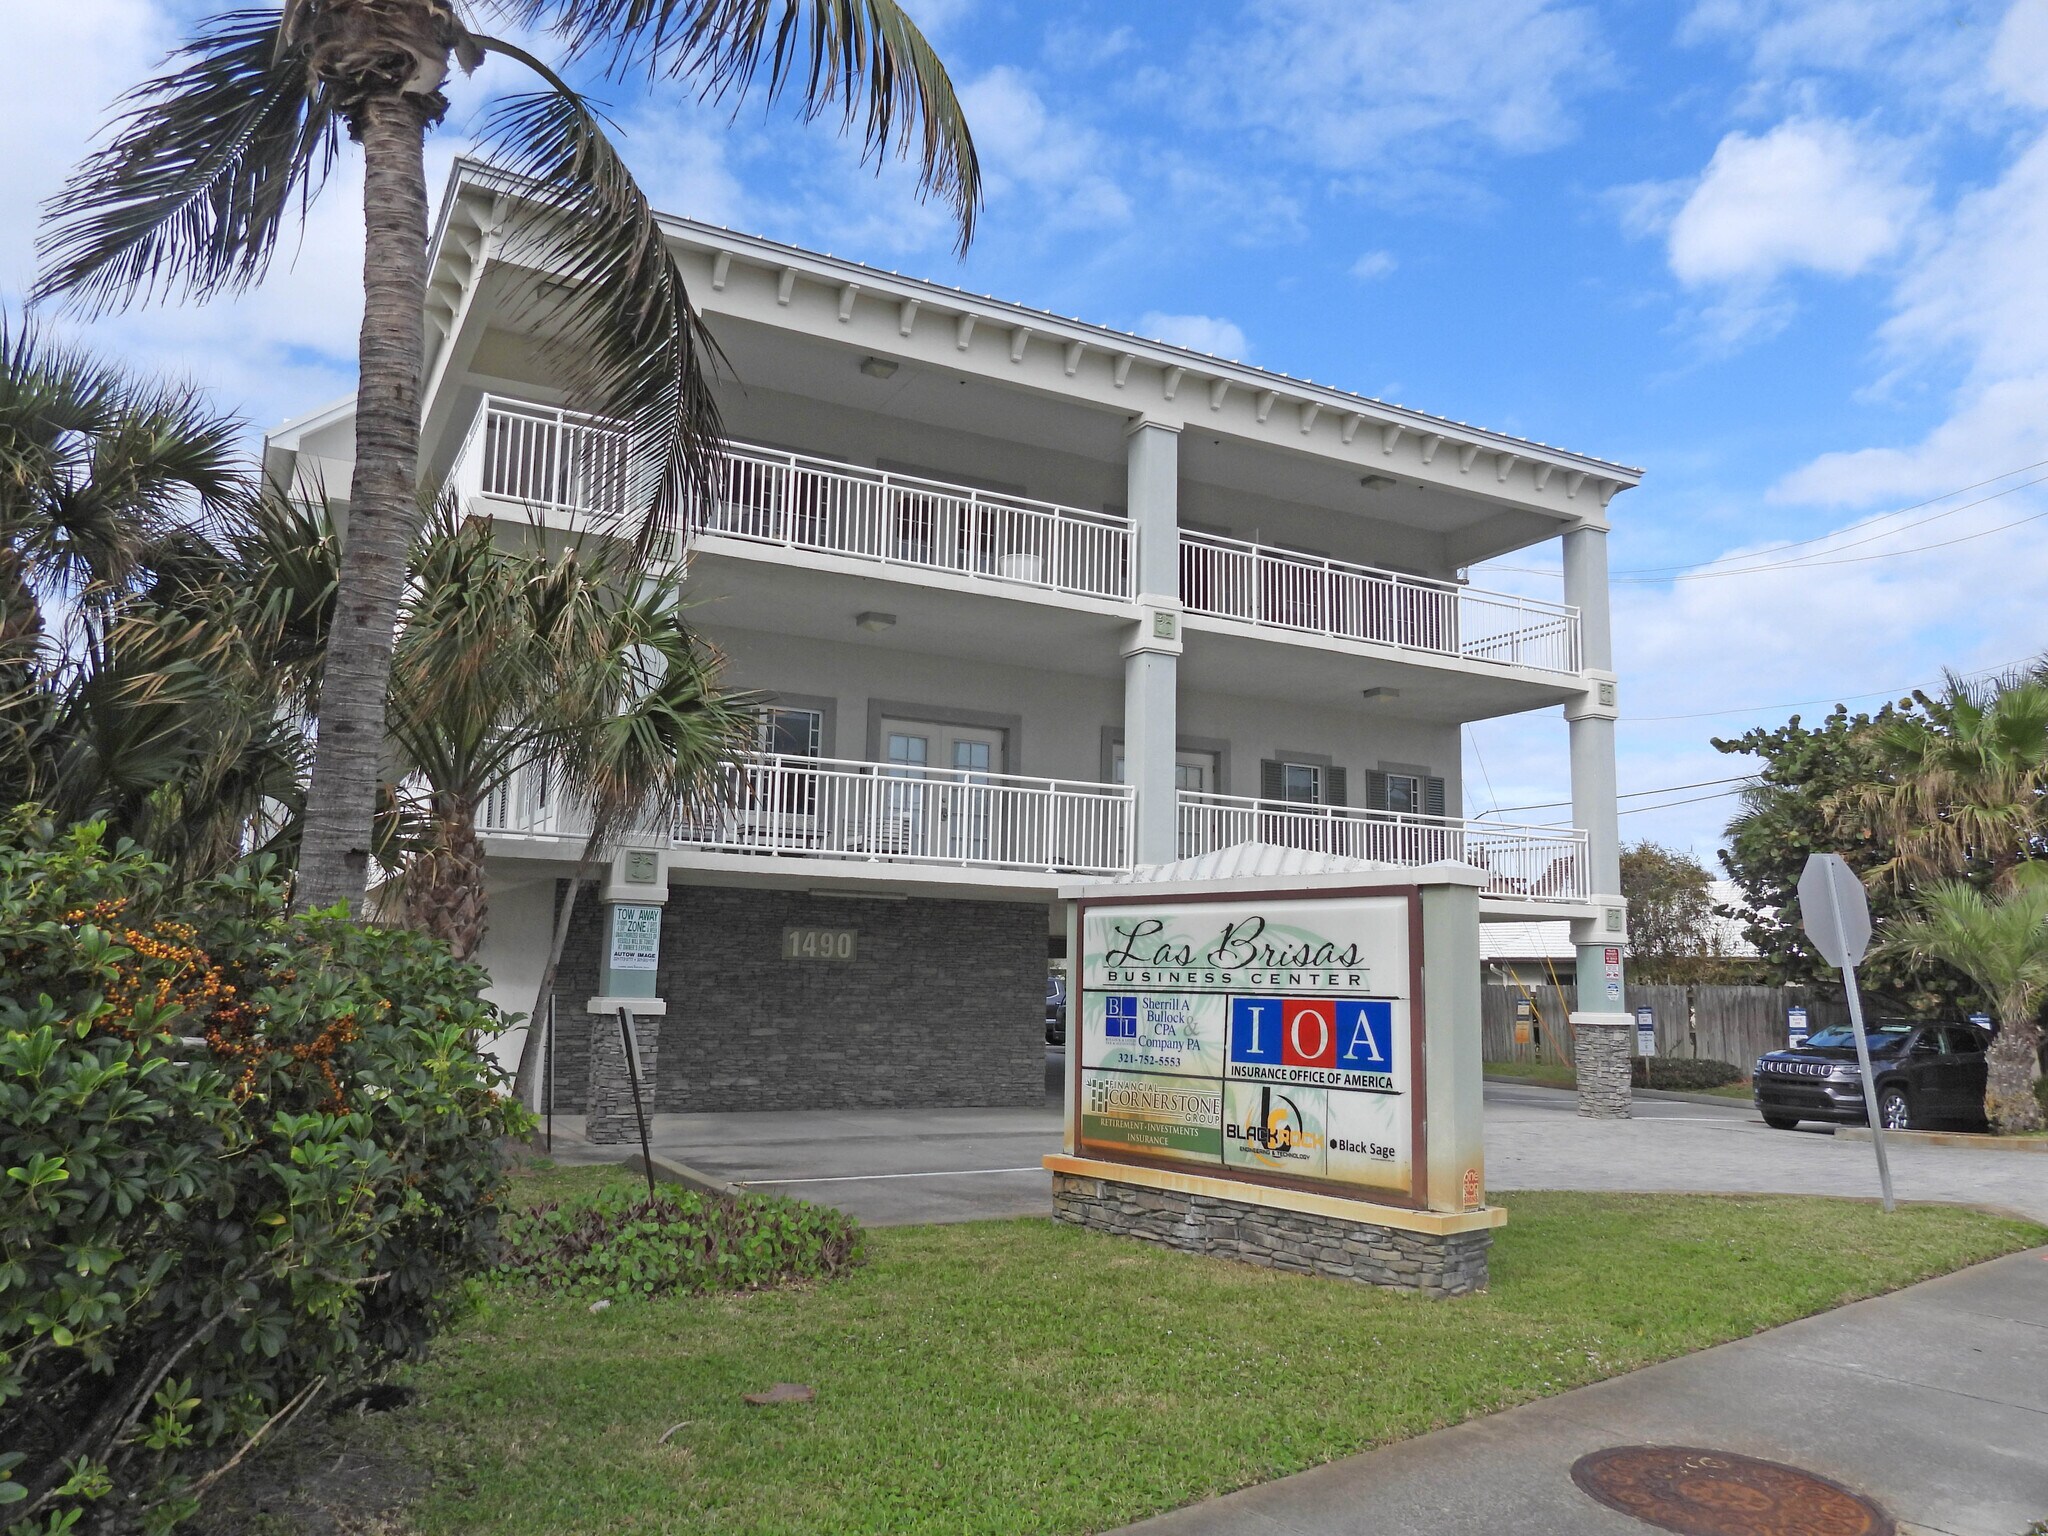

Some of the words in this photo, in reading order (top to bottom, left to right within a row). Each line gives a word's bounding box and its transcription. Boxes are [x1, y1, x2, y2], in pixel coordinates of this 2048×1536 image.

[618, 908, 635, 920] TOW
[639, 910, 659, 921] AWAY
[628, 921, 647, 932] ZONE
[789, 931, 851, 958] 1490
[1106, 919, 1197, 968] Las
[1207, 916, 1365, 969] Brisas
[1108, 970, 1232, 984] BUSINESS
[1251, 973, 1361, 986] CENTER
[1142, 997, 1179, 1010] Sherrill
[1181, 999, 1190, 1011] A
[1147, 1010, 1185, 1024] Bullock
[1154, 1023, 1176, 1036] CPA
[1138, 1035, 1184, 1052] Company
[1187, 1038, 1200, 1050] PA
[1118, 1053, 1181, 1067] 321-752-5553
[1231, 1065, 1287, 1080] INSURANCE
[1289, 1069, 1324, 1084] OFFICE
[1327, 1072, 1341, 1085] OF
[1343, 1073, 1393, 1089] AMERICA
[1109, 1080, 1159, 1093] FINANCIAL
[1108, 1089, 1221, 1115] CORNERSTONE
[1185, 1113, 1220, 1124] GROUP
[1100, 1118, 1144, 1131] RETIREMENT
[1147, 1123, 1199, 1137] INVESTMENTS
[1127, 1133, 1169, 1146] INSURANCE
[1339, 1139, 1367, 1154] Black
[1369, 1143, 1395, 1159] Sage
